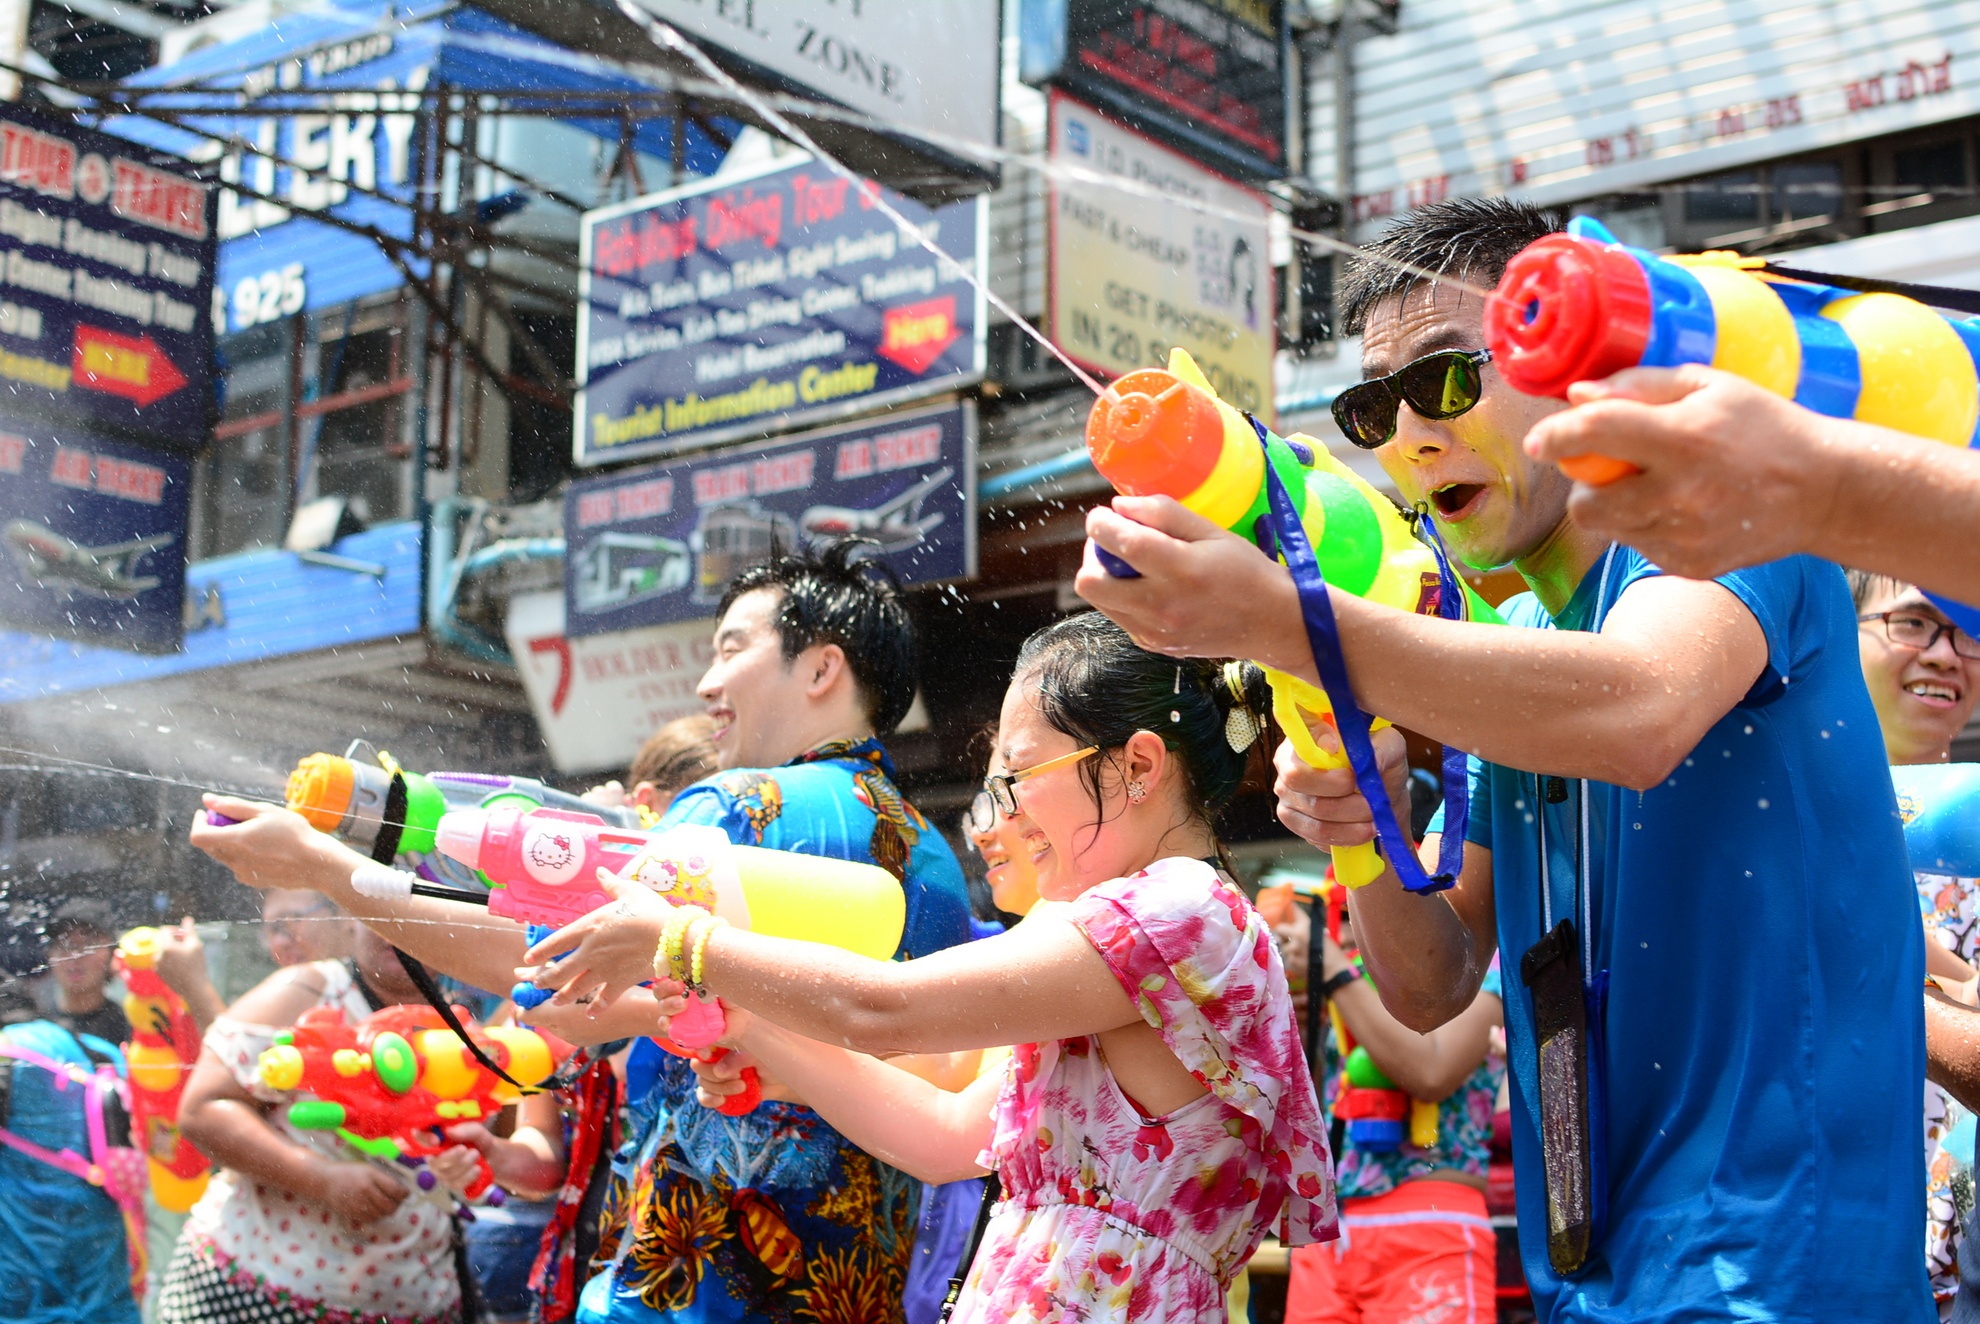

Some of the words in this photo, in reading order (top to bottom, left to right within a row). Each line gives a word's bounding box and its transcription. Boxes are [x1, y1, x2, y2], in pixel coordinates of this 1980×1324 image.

[795, 20, 906, 104] ZONE
[0, 120, 76, 199] TOUR
[110, 157, 206, 240] TRAVEL
[186, 64, 430, 243] LLERY
[594, 211, 698, 278] Fabulous
[706, 187, 783, 250] Diving
[791, 174, 849, 228] Tour
[1061, 194, 1106, 230] FAST
[1107, 215, 1121, 243] &
[1124, 224, 1191, 268] CHEAP
[147, 242, 201, 288] Tour
[233, 260, 306, 330] 925
[700, 268, 731, 299] Bus
[788, 242, 834, 279] Sight
[835, 230, 896, 266] Seeing
[153, 290, 197, 335] Tour
[748, 296, 801, 331] Diving
[888, 312, 949, 352] Here
[1103, 279, 1150, 321] GET
[1154, 299, 1236, 352] PHOTO
[744, 328, 847, 375] Reservation
[1071, 306, 1102, 350] IN
[1106, 322, 1142, 366] 20
[1147, 338, 1263, 415] SOND
[594, 405, 664, 448] Tourist
[665, 376, 797, 432] Information
[799, 361, 879, 404] Center
[52, 447, 92, 490] AIR
[95, 453, 168, 507] TICKET
[692, 465, 752, 508] TRAIN
[752, 449, 817, 498] TICKET
[833, 437, 873, 482] AIR
[874, 423, 942, 473] TICKET
[577, 489, 615, 530] BUS
[616, 475, 675, 522] TICKET
